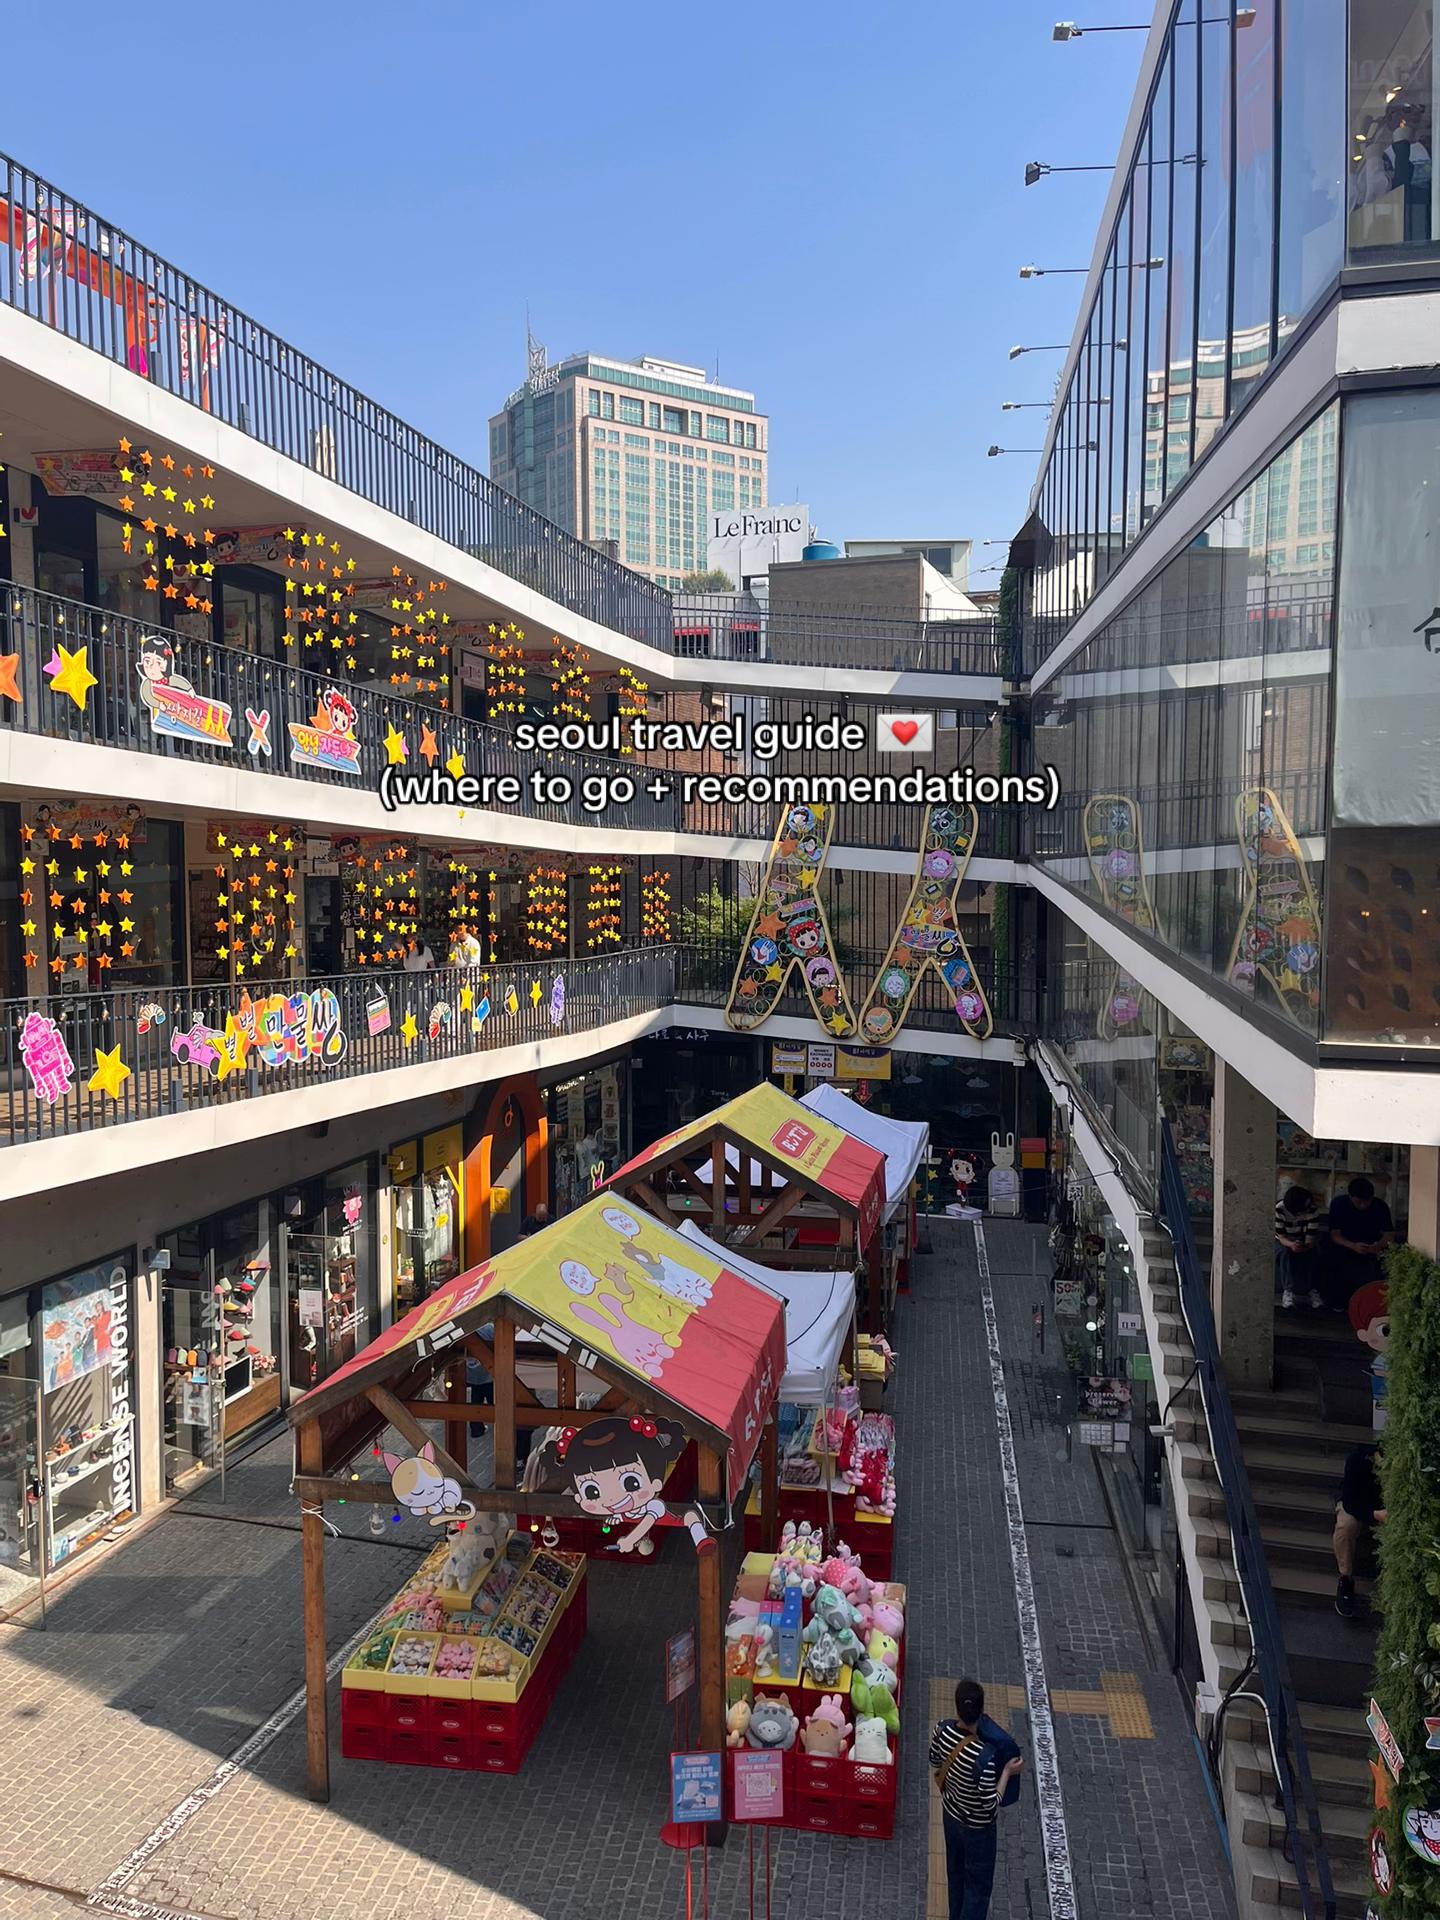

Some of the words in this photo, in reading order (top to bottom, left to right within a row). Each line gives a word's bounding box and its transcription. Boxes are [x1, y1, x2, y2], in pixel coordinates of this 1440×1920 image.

[686, 1029, 710, 1041] 사주
[110, 1266, 129, 1379] WORLD
[111, 1379, 132, 1514] INCENSE
